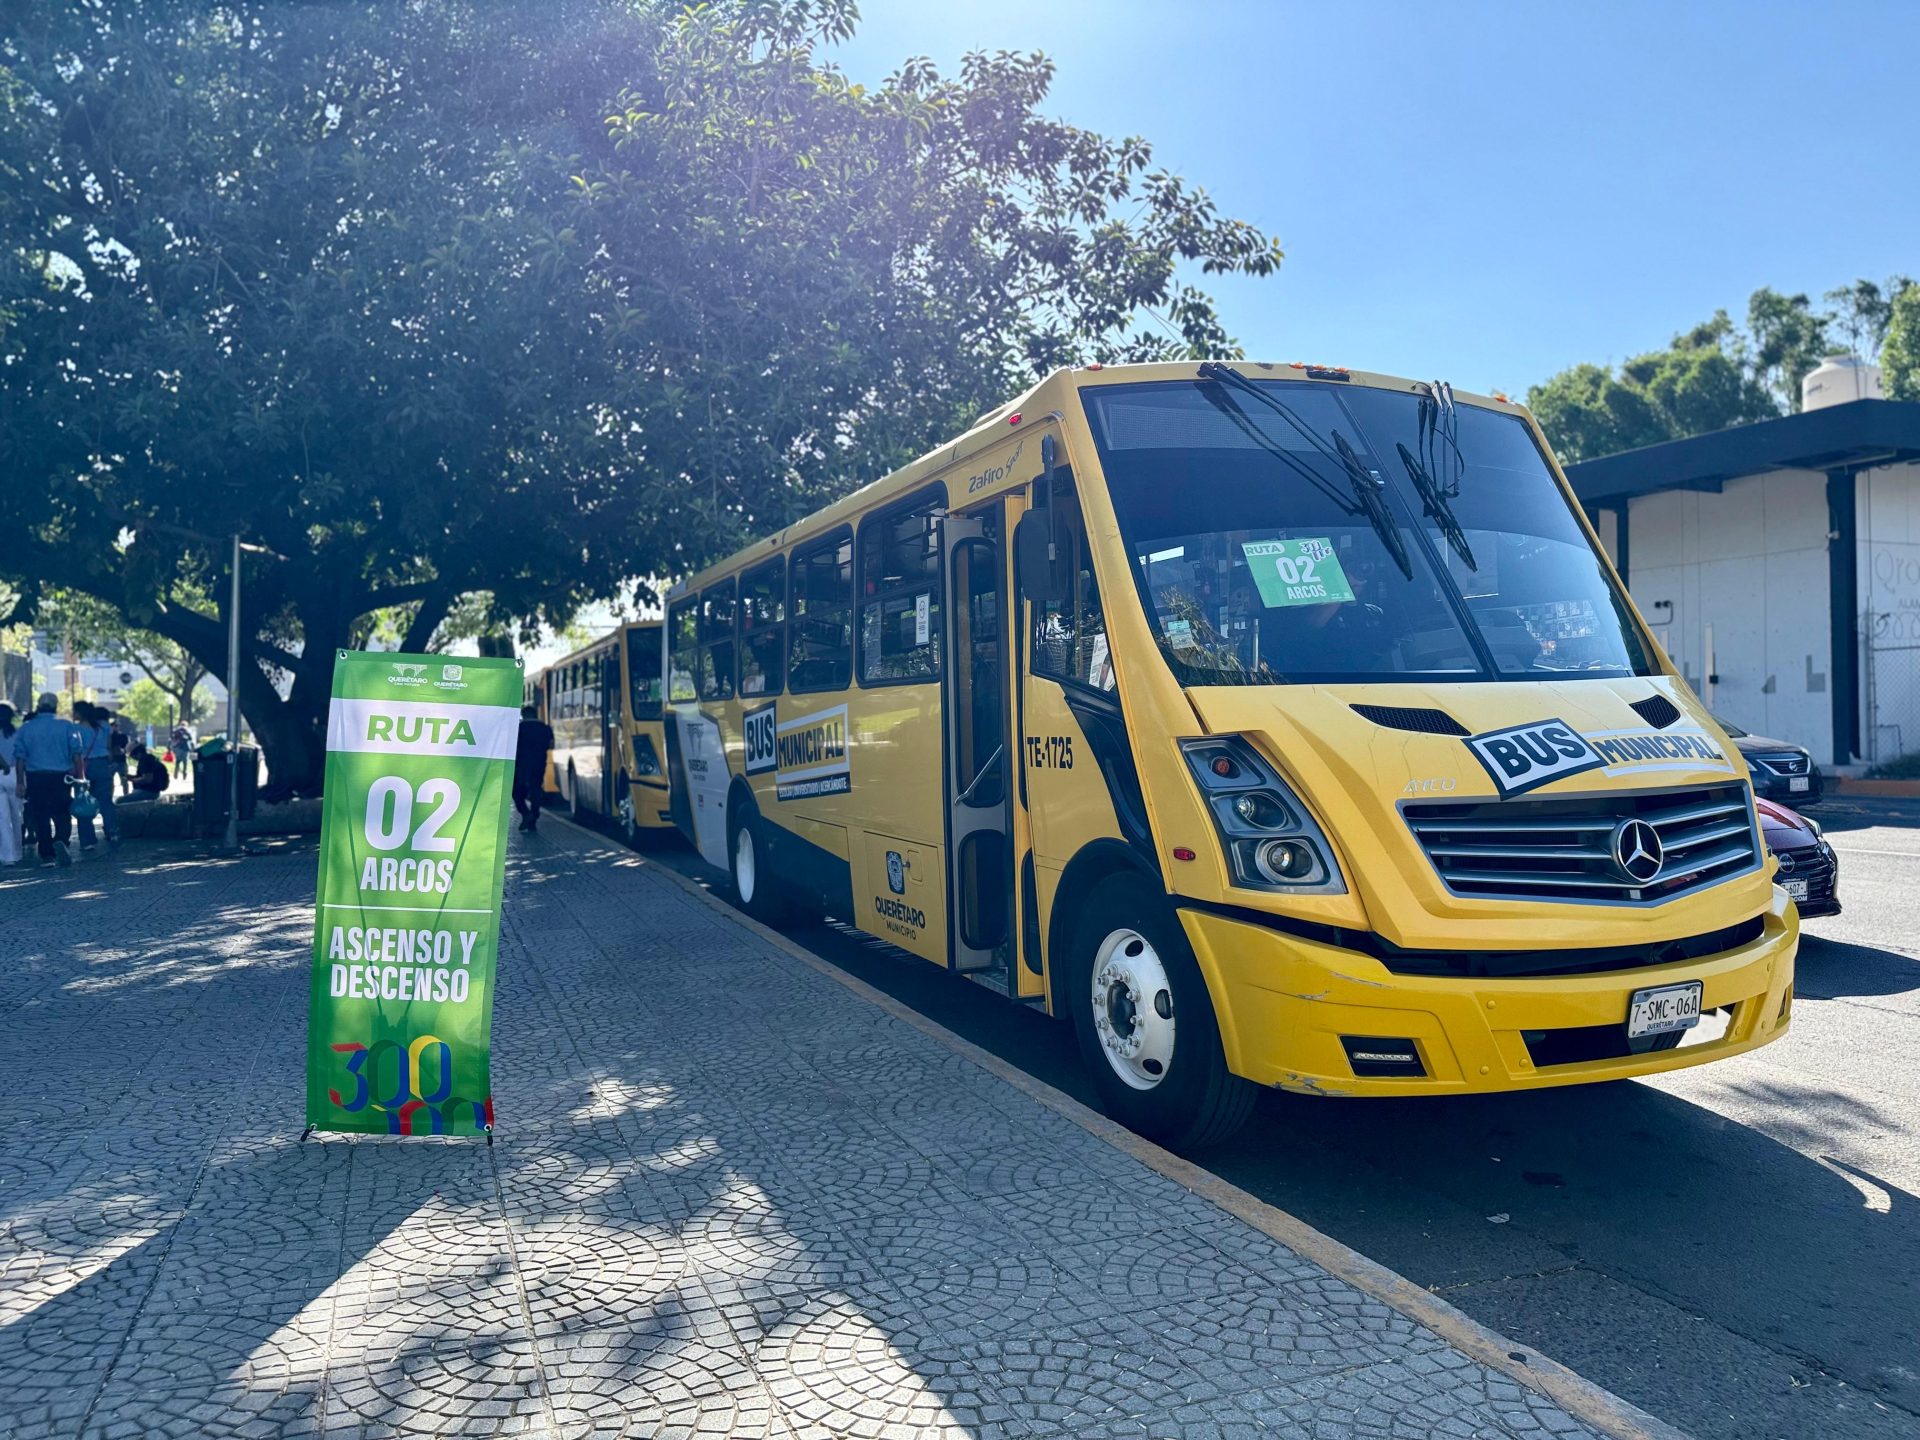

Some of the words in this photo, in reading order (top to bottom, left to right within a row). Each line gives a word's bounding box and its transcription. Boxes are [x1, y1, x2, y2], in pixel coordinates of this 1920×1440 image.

[968, 466, 1004, 494] Zafiro
[1245, 544, 1281, 556] RUTA
[1275, 555, 1321, 584] 02
[1286, 584, 1328, 600] ARCOS
[387, 676, 428, 684] QUERÉTARO
[366, 714, 477, 746] RUTA
[746, 714, 774, 762] BUS
[778, 722, 844, 768] MUNICIPAL
[1026, 736, 1073, 770] TE-1725
[1481, 727, 1587, 779] BUS
[1591, 735, 1724, 764] MUNICIPAL
[364, 775, 461, 853] 02
[359, 856, 454, 894] ARCOS
[875, 896, 926, 929] QUERÉTARO
[329, 926, 452, 965] ASCENSO
[459, 930, 478, 965] Y
[886, 920, 917, 941] MUNICIPIO
[330, 964, 470, 1003] DESCENSO
[1633, 994, 1698, 1024] 7-SMC-06A
[328, 1034, 452, 1113] 300
